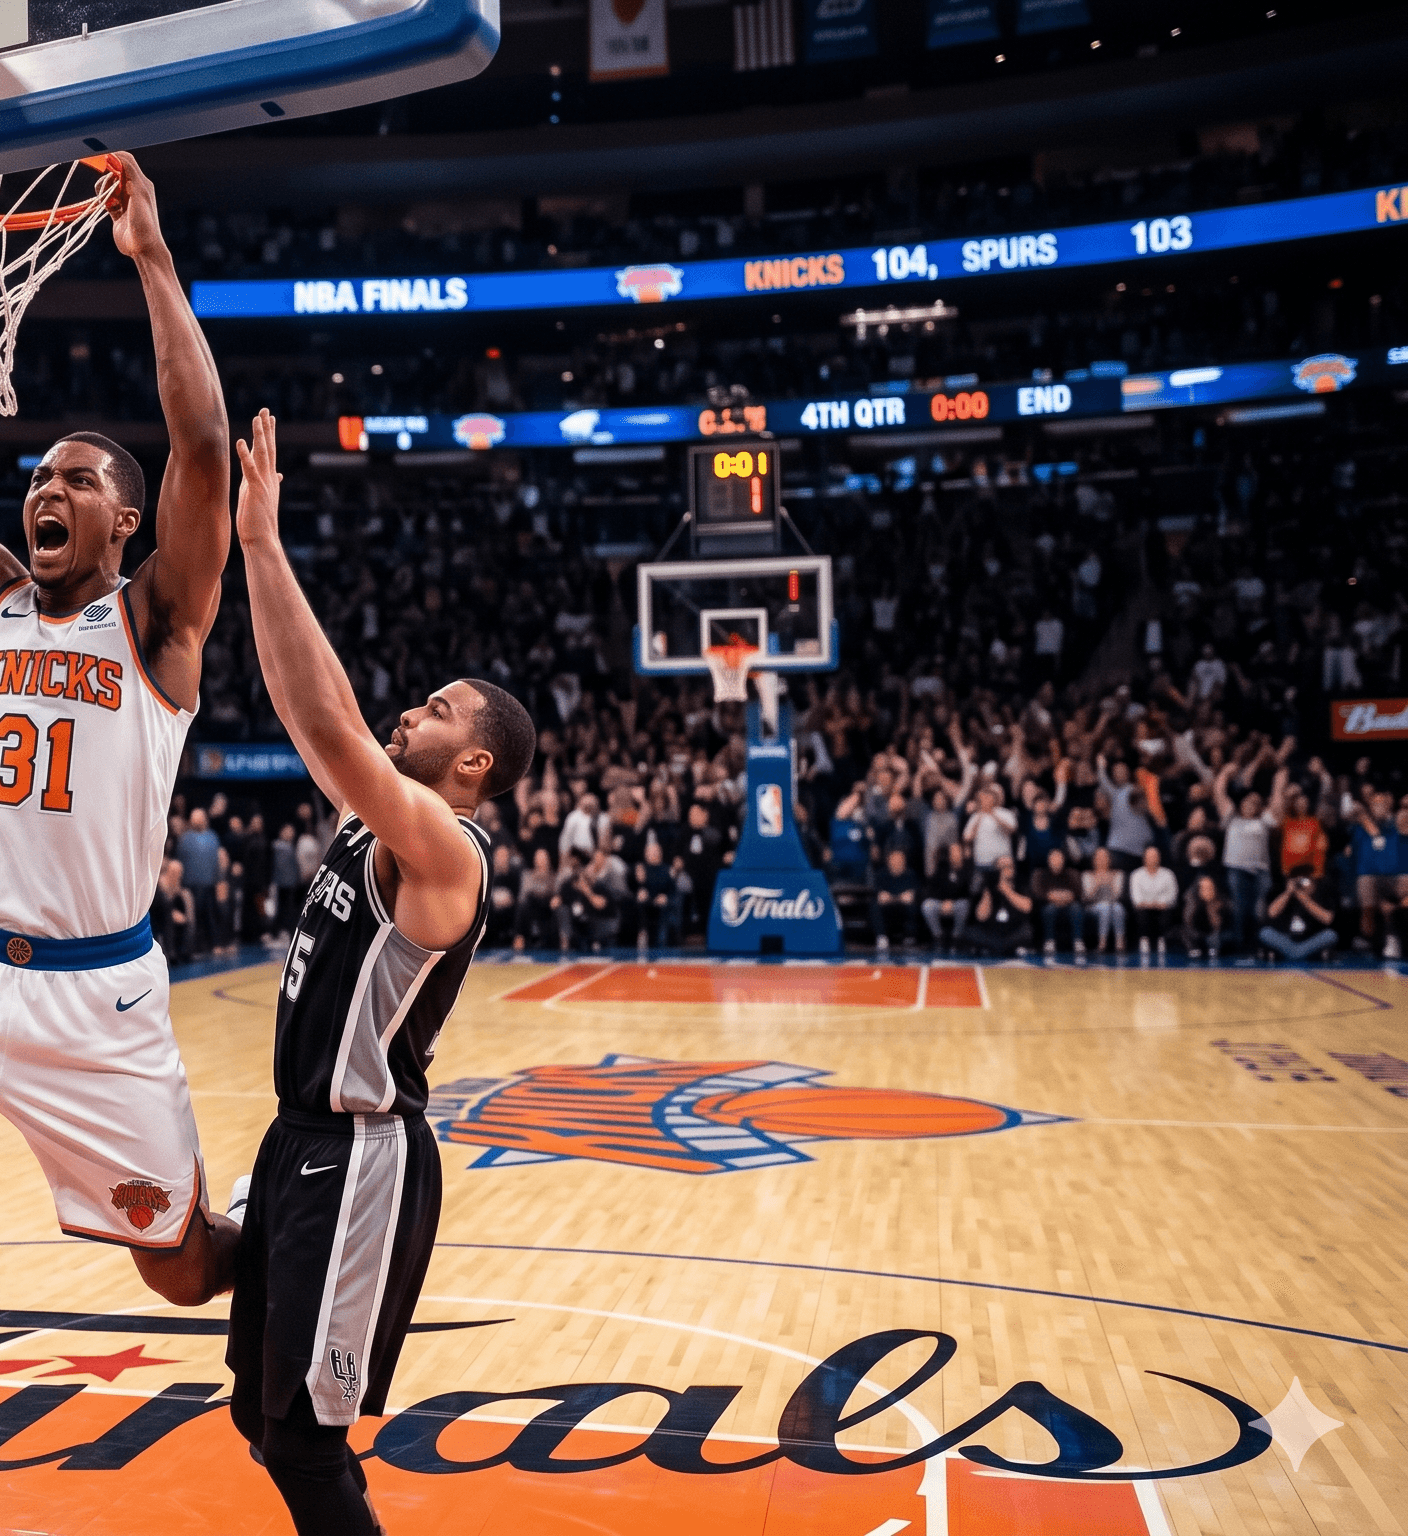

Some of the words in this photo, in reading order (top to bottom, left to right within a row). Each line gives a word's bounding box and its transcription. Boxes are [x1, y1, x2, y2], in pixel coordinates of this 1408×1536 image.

[1375, 186, 1408, 223] K
[744, 253, 845, 291] KNICKS
[872, 244, 938, 281] 104,
[962, 233, 1058, 272] SPURS
[1130, 215, 1193, 254] 103
[293, 280, 358, 313] NBA
[362, 277, 468, 311] FINALS
[800, 401, 849, 430] 4TH
[854, 397, 906, 428] QTR
[931, 391, 989, 421] 0:00
[1017, 385, 1072, 415] END
[723, 886, 826, 928] Finals
